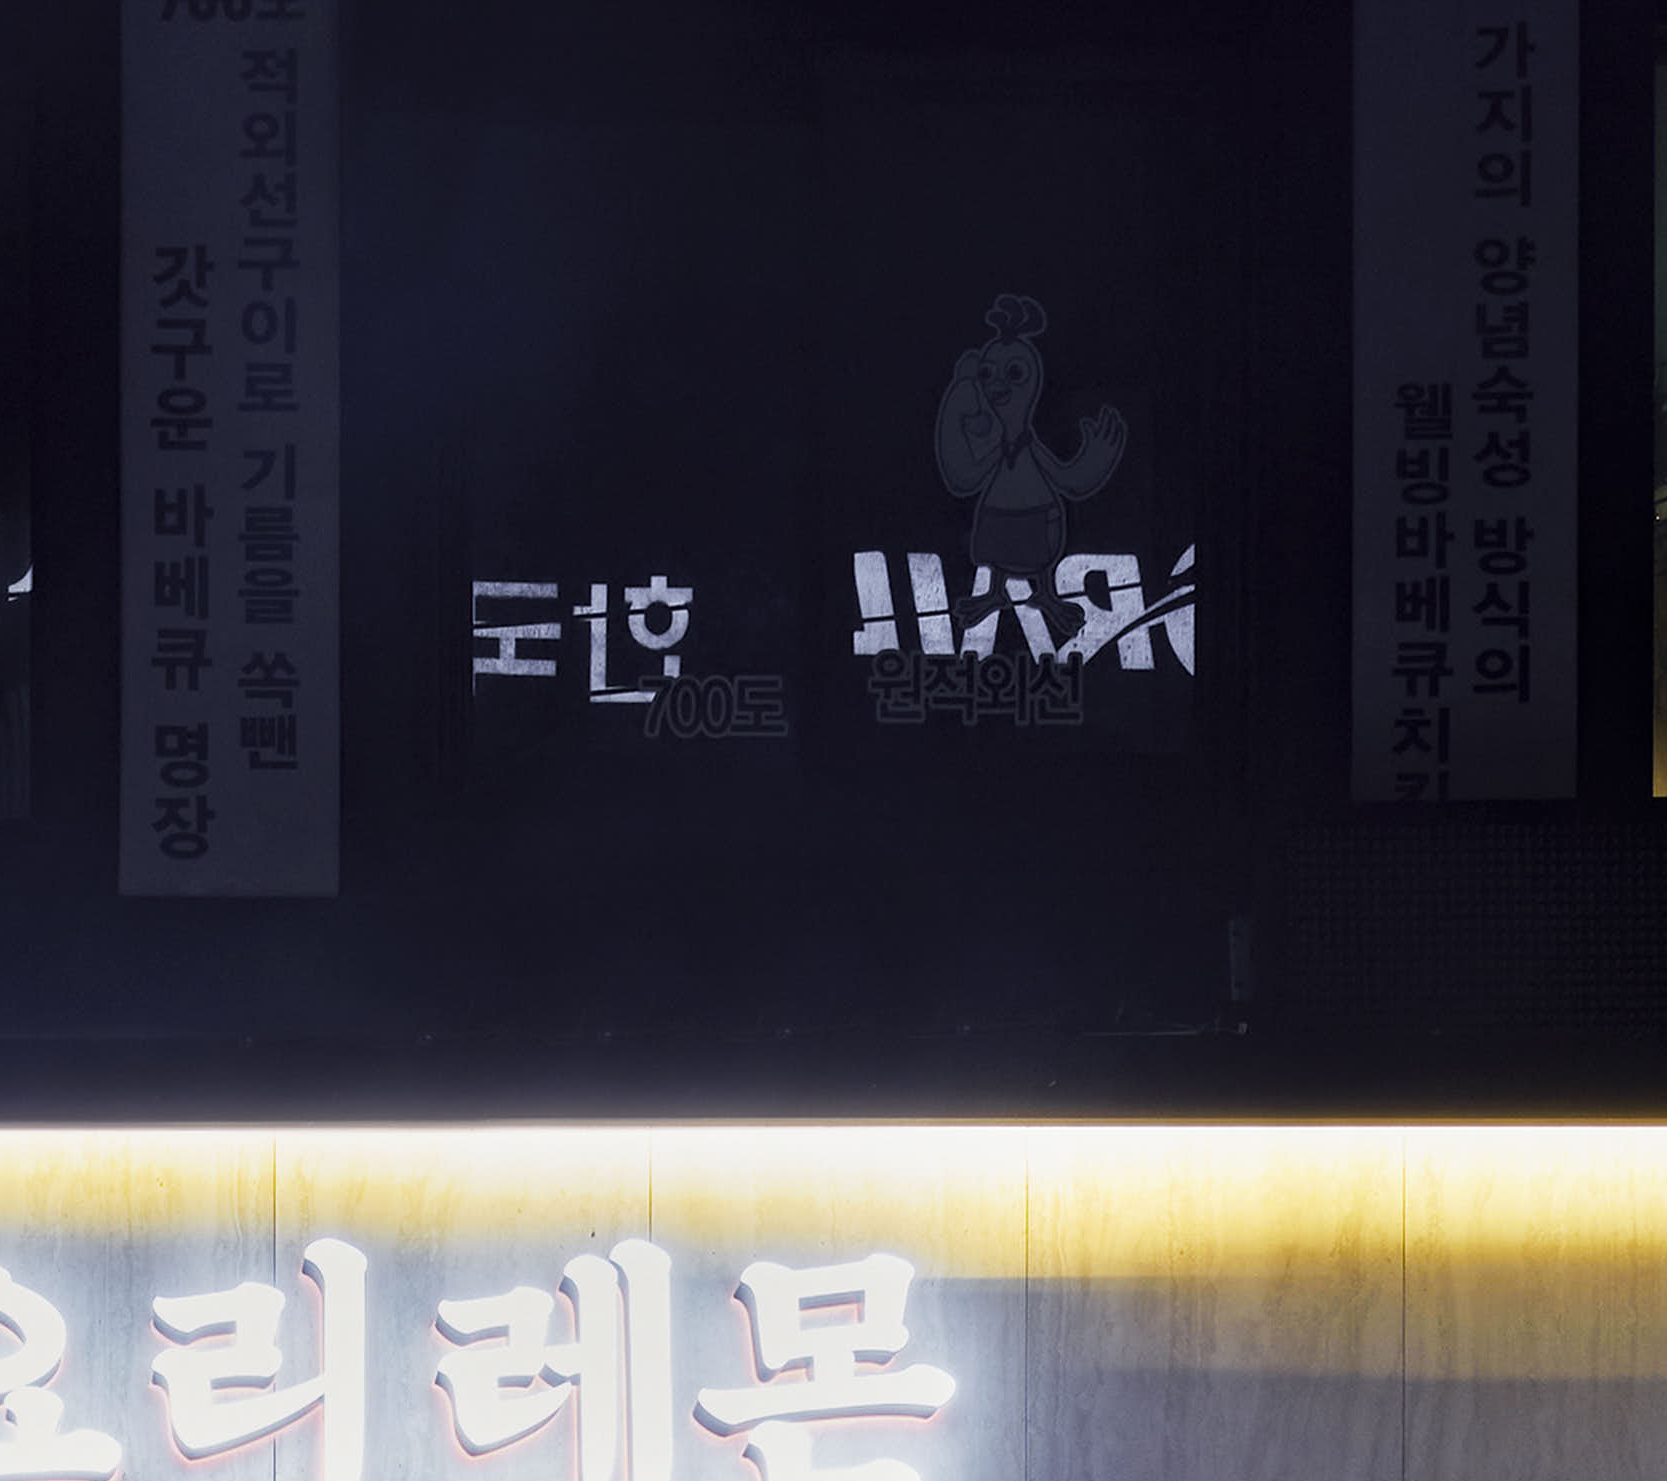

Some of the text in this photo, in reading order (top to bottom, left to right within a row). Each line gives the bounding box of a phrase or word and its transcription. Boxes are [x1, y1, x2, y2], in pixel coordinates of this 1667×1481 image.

[151, 488, 213, 692] 바베큐
[237, 445, 301, 626] 기름을
[1472, 517, 1535, 704] 방식의
[151, 721, 215, 861] 명장
